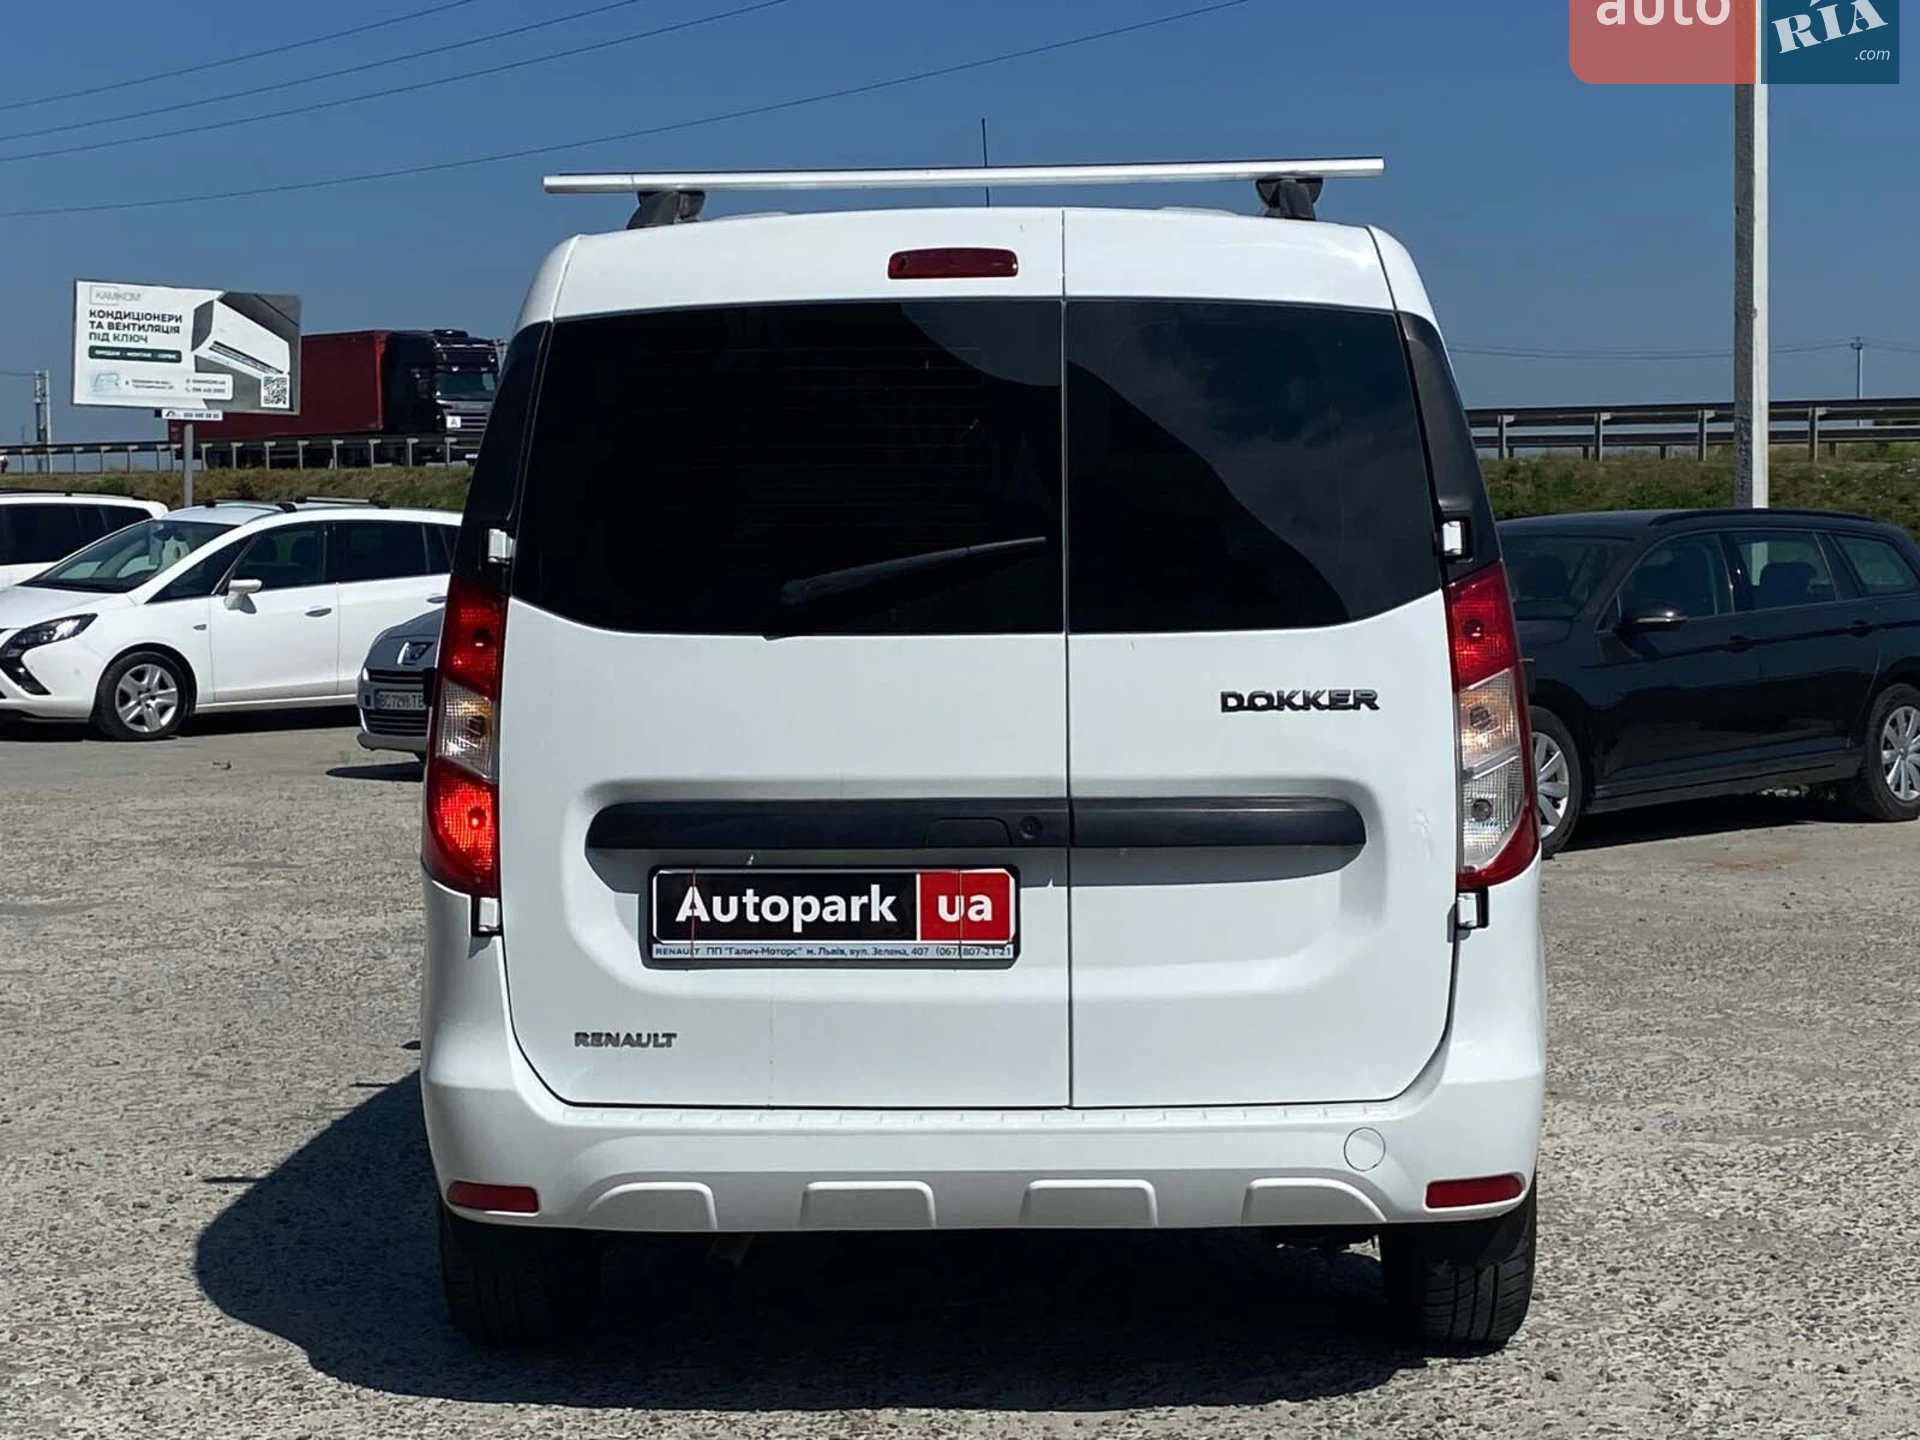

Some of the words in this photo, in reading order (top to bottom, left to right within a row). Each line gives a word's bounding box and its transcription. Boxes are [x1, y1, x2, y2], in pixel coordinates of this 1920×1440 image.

[89, 309, 183, 323] КОНДИЦІОНЕРИ
[89, 320, 104, 331] ТА
[107, 321, 181, 335] ВЕНТИЛЯЦІЯ
[89, 332, 110, 342] ПІД
[113, 332, 148, 343] КЛЮЧ
[1220, 689, 1380, 712] DOKKER
[675, 884, 897, 933] Autopark
[936, 893, 993, 922] ua
[706, 946, 722, 955] ПП
[911, 946, 929, 956] 407
[574, 1031, 677, 1048] RENAULT
